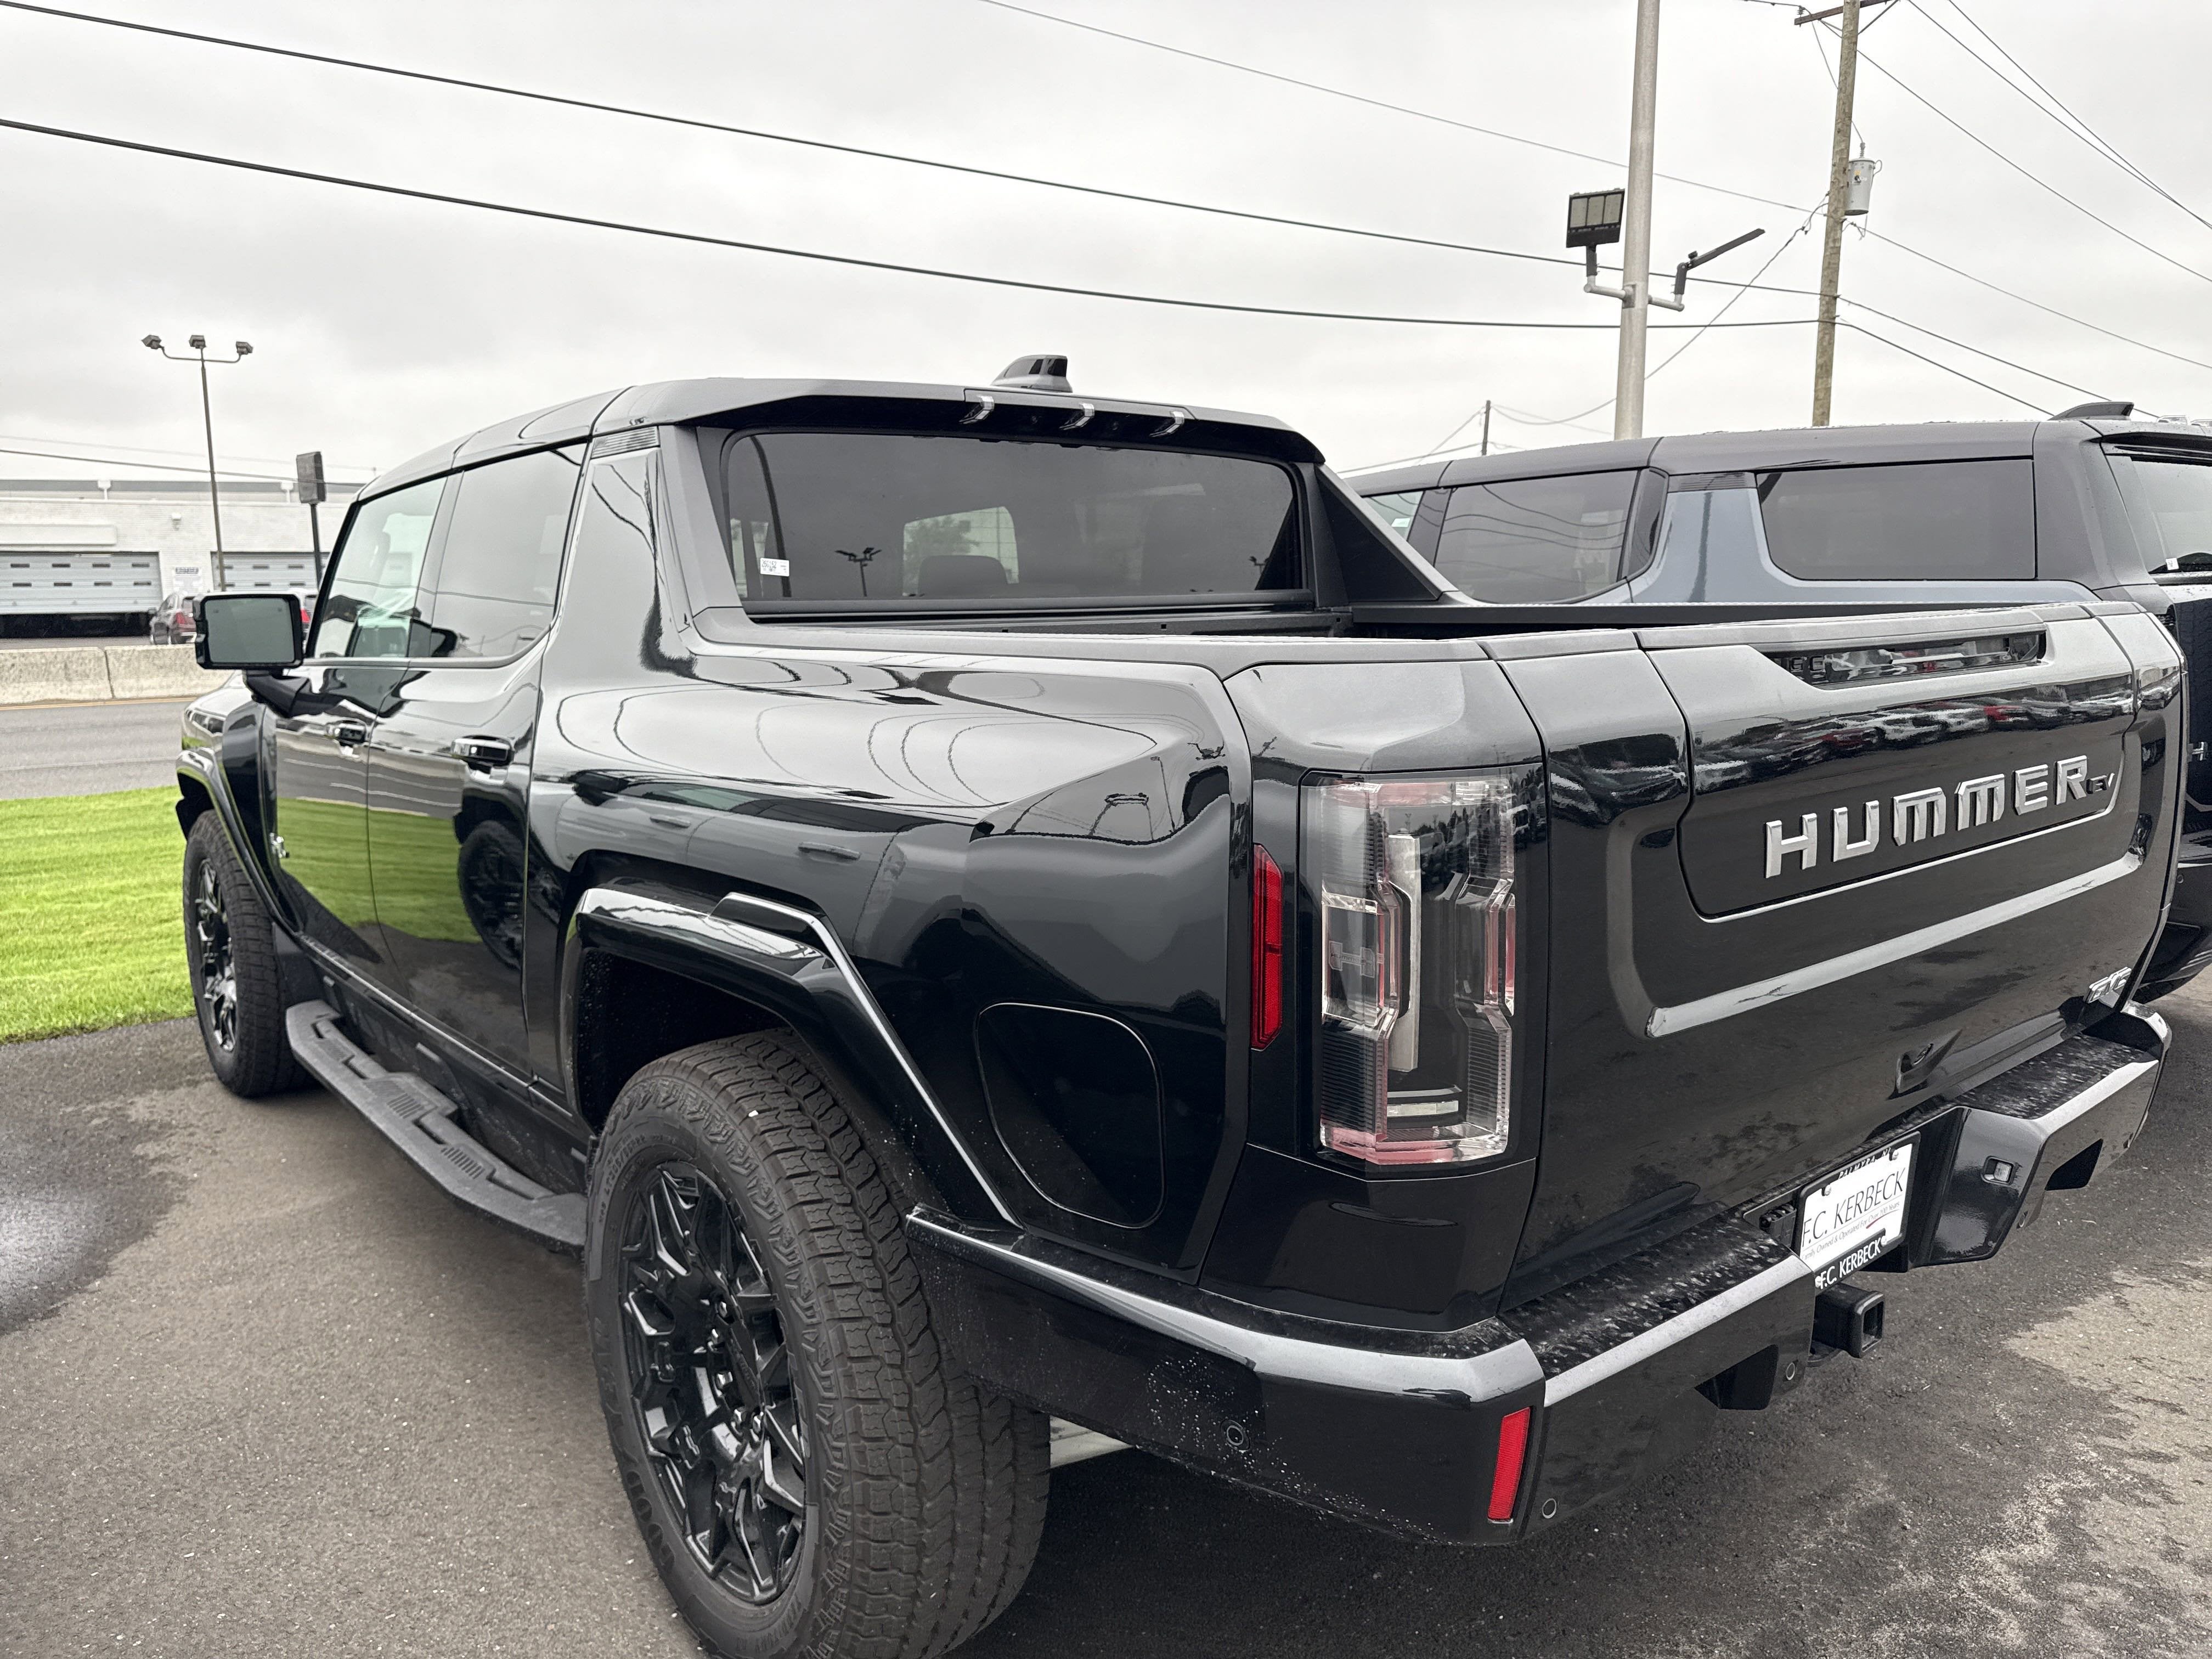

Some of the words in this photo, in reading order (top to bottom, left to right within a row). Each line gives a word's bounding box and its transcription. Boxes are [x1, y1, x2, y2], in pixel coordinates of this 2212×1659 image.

[1765, 755, 2087, 878] HUMMER
[2086, 772, 2115, 794] EV
[1802, 1210, 1827, 1248] F.C.
[1834, 1167, 1906, 1229] KERBECK
[1816, 1235, 1834, 1253] Owned
[1839, 1221, 1860, 1242] Operated
[1868, 1211, 1879, 1224] Over
[1819, 1266, 1837, 1290] F.C.
[1839, 1237, 1882, 1280] KERBECK
